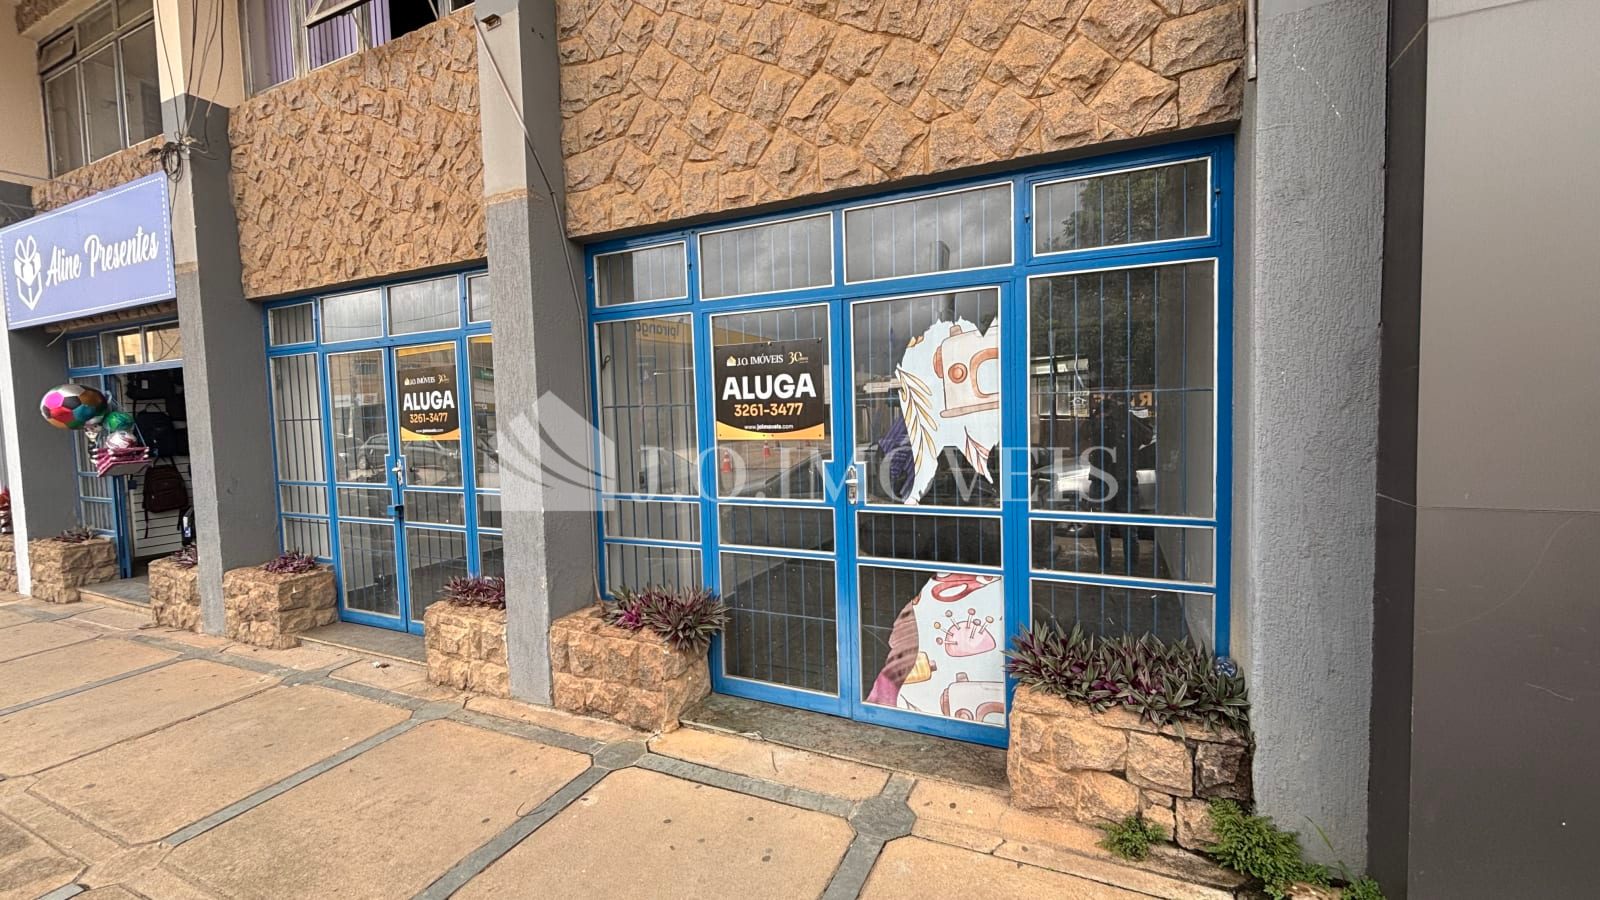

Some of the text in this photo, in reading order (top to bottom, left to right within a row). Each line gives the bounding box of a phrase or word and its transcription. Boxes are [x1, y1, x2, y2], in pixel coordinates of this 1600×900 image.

[46, 226, 159, 287] Aline Presentes
[750, 353, 784, 365] IMÓVEIS
[722, 372, 817, 401] ALUGA
[403, 390, 456, 412] ALUGA
[734, 402, 803, 417] 3261-3477
[409, 412, 448, 424] 3261-3477
